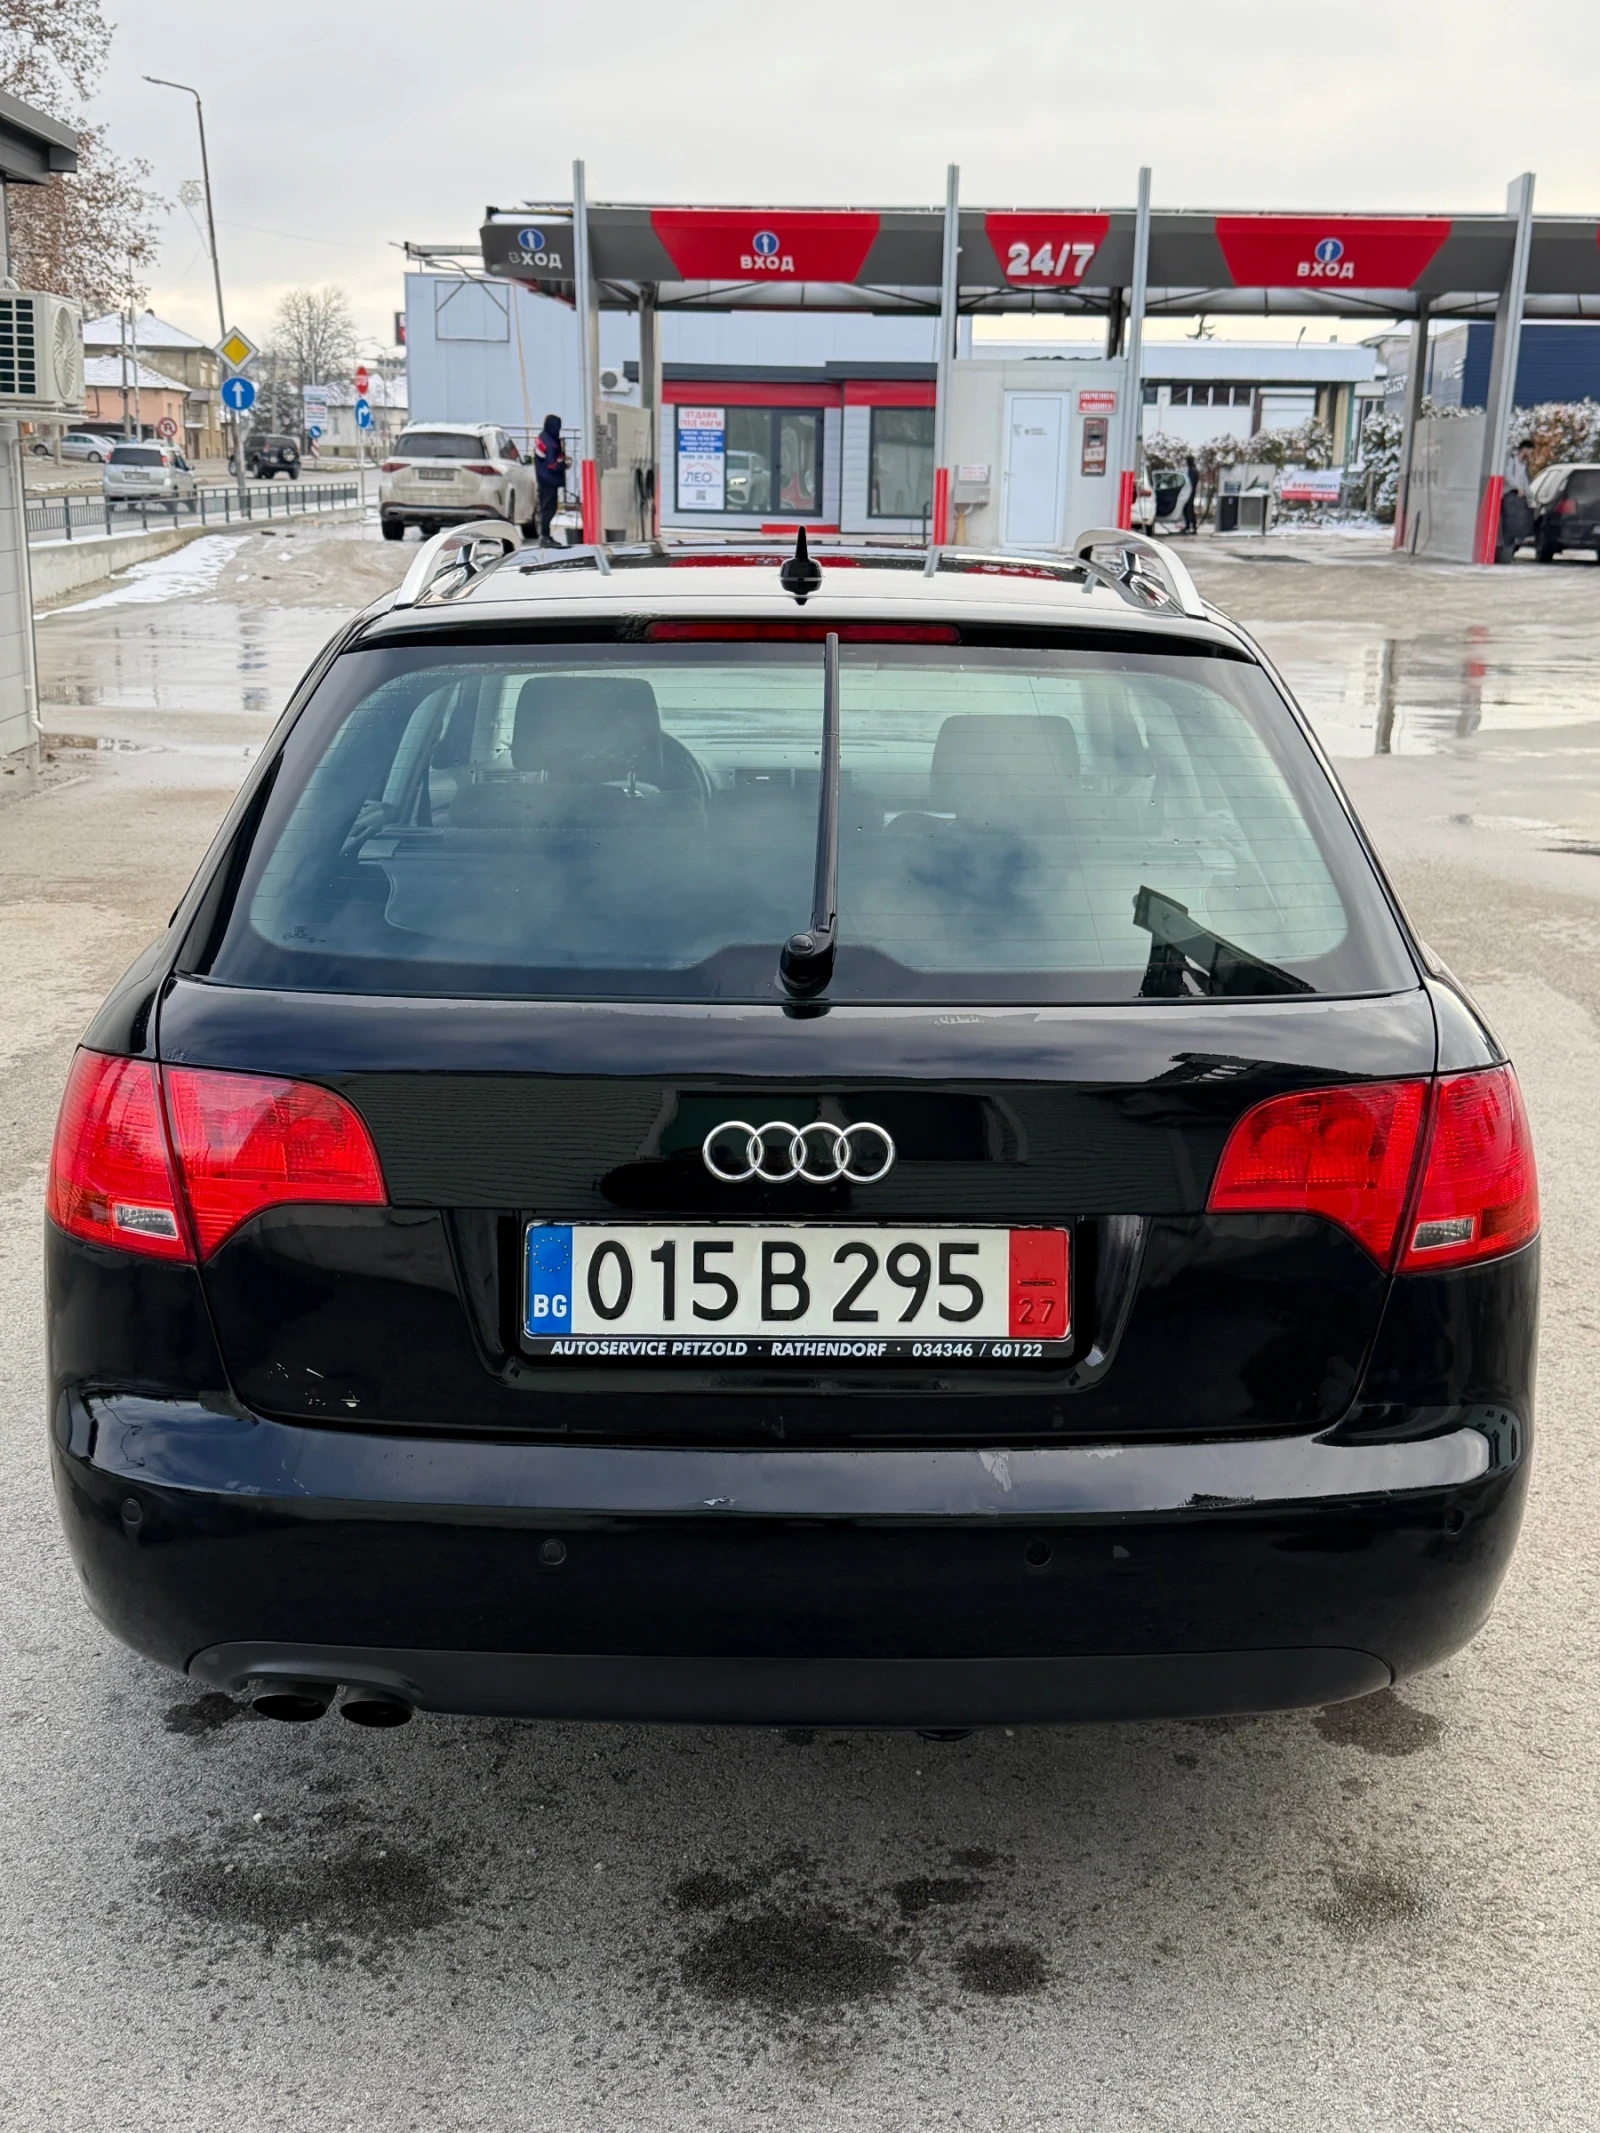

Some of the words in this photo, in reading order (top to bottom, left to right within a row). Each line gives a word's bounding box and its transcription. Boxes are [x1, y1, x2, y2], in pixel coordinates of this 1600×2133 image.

[740, 254, 795, 273] ВХОД
[1006, 242, 1096, 277] 24/7
[1297, 261, 1355, 280] ВХОД
[684, 471, 713, 483] ЛЕО
[533, 1294, 567, 1318] BG
[1018, 1297, 1056, 1325] 27
[550, 1341, 668, 1356] AUTOSERVICE
[671, 1341, 748, 1356] PETZOLD
[771, 1342, 888, 1357] RATHENDORF
[912, 1342, 974, 1358] 034346
[991, 1343, 1043, 1358] 60122
